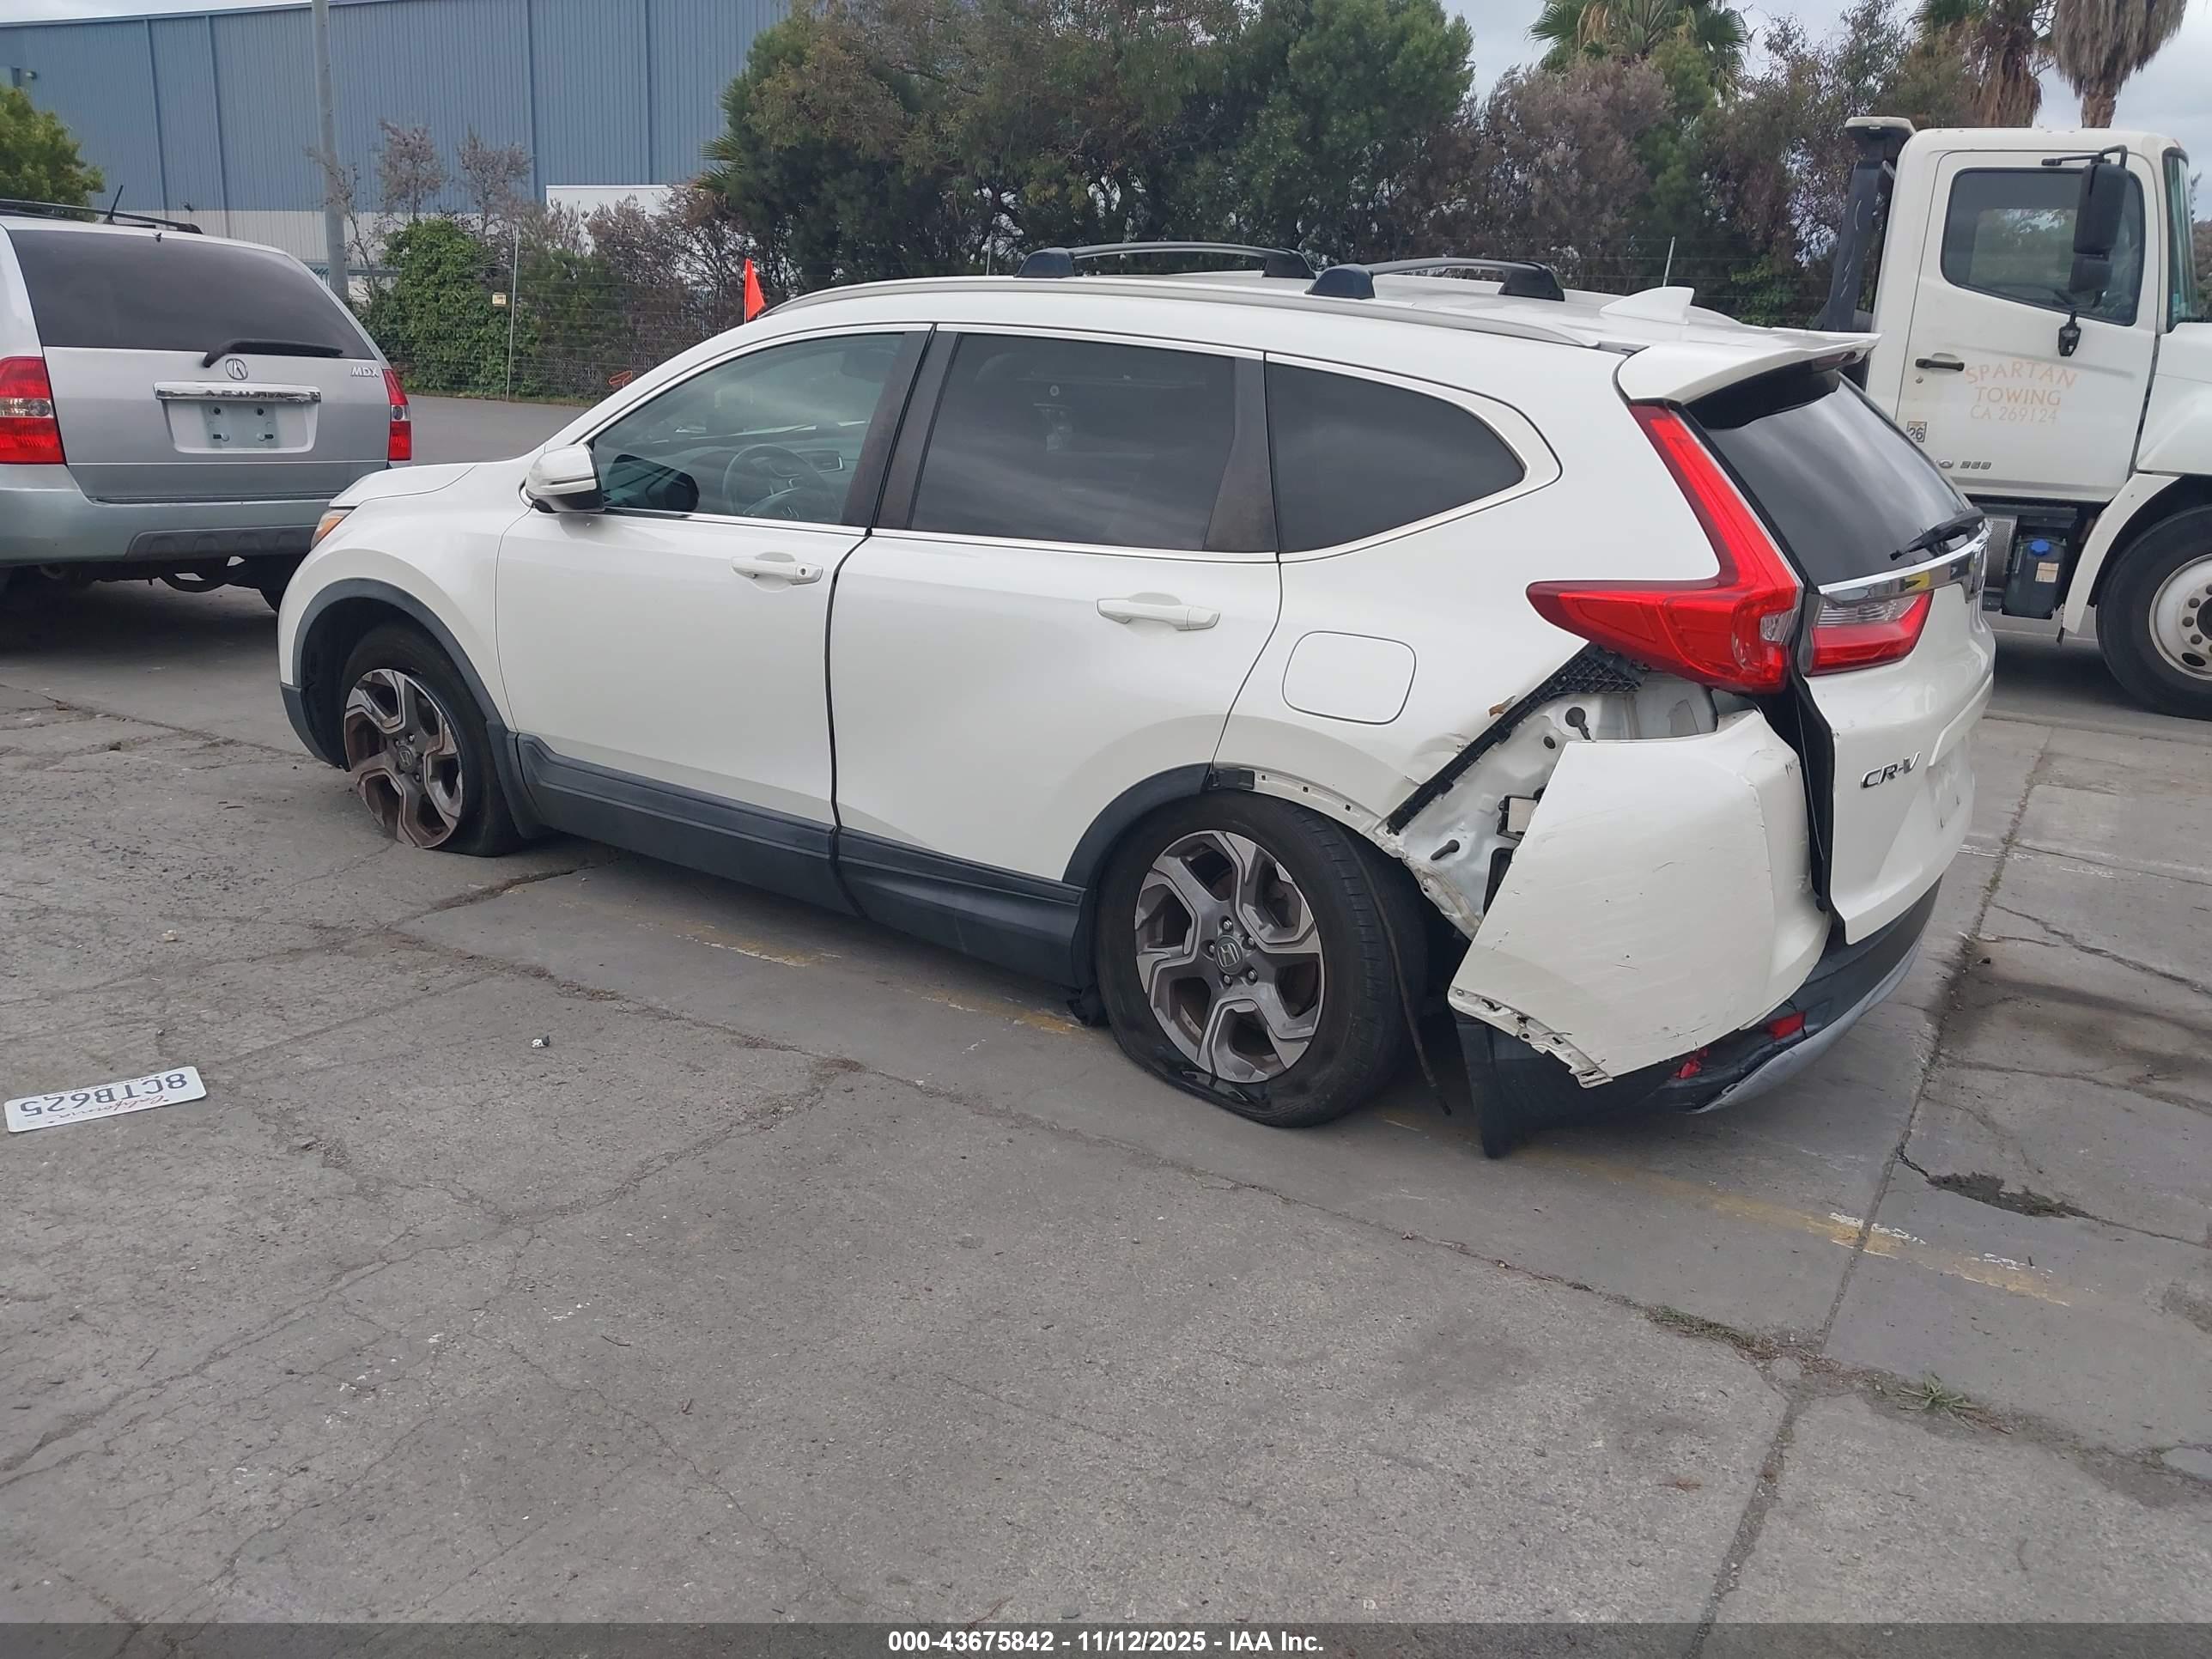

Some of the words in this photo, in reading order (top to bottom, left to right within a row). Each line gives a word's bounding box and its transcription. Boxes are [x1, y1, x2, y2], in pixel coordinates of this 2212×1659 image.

[350, 366, 380, 377] MDX
[1965, 361, 2077, 388] SPARTAN
[1975, 386, 2061, 406] TOWING
[1970, 405, 1992, 420] CA
[1998, 406, 2058, 424] 269124
[1861, 750, 1921, 788] CR-V
[20, 1073, 188, 1117] 8CTB625
[53, 1094, 165, 1120] California
